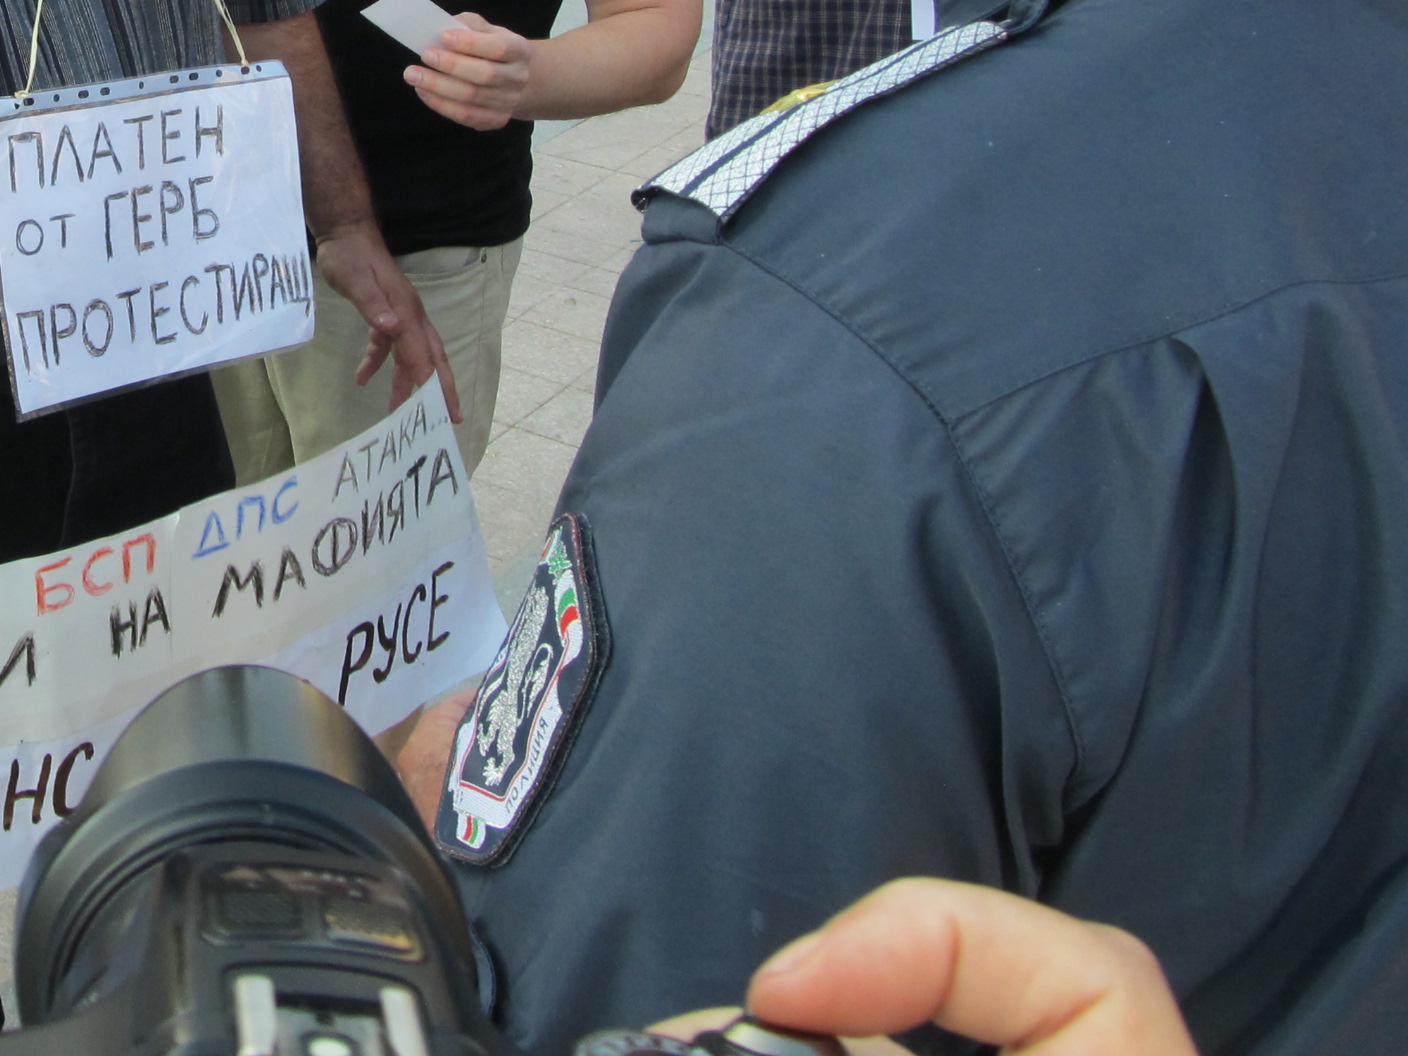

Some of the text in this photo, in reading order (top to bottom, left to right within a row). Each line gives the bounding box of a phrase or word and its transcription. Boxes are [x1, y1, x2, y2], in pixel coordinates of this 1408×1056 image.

[7, 104, 225, 193] ПЛАТЕН
[103, 175, 220, 262] ГЕРБ
[16, 250, 311, 375] ПРОТЕСТИРАЩ
[33, 533, 156, 617] БСП
[191, 476, 299, 560] ДПС
[109, 586, 172, 660] НА
[211, 447, 460, 619] МАФИЯТА
[337, 560, 455, 706] РУСЕ
